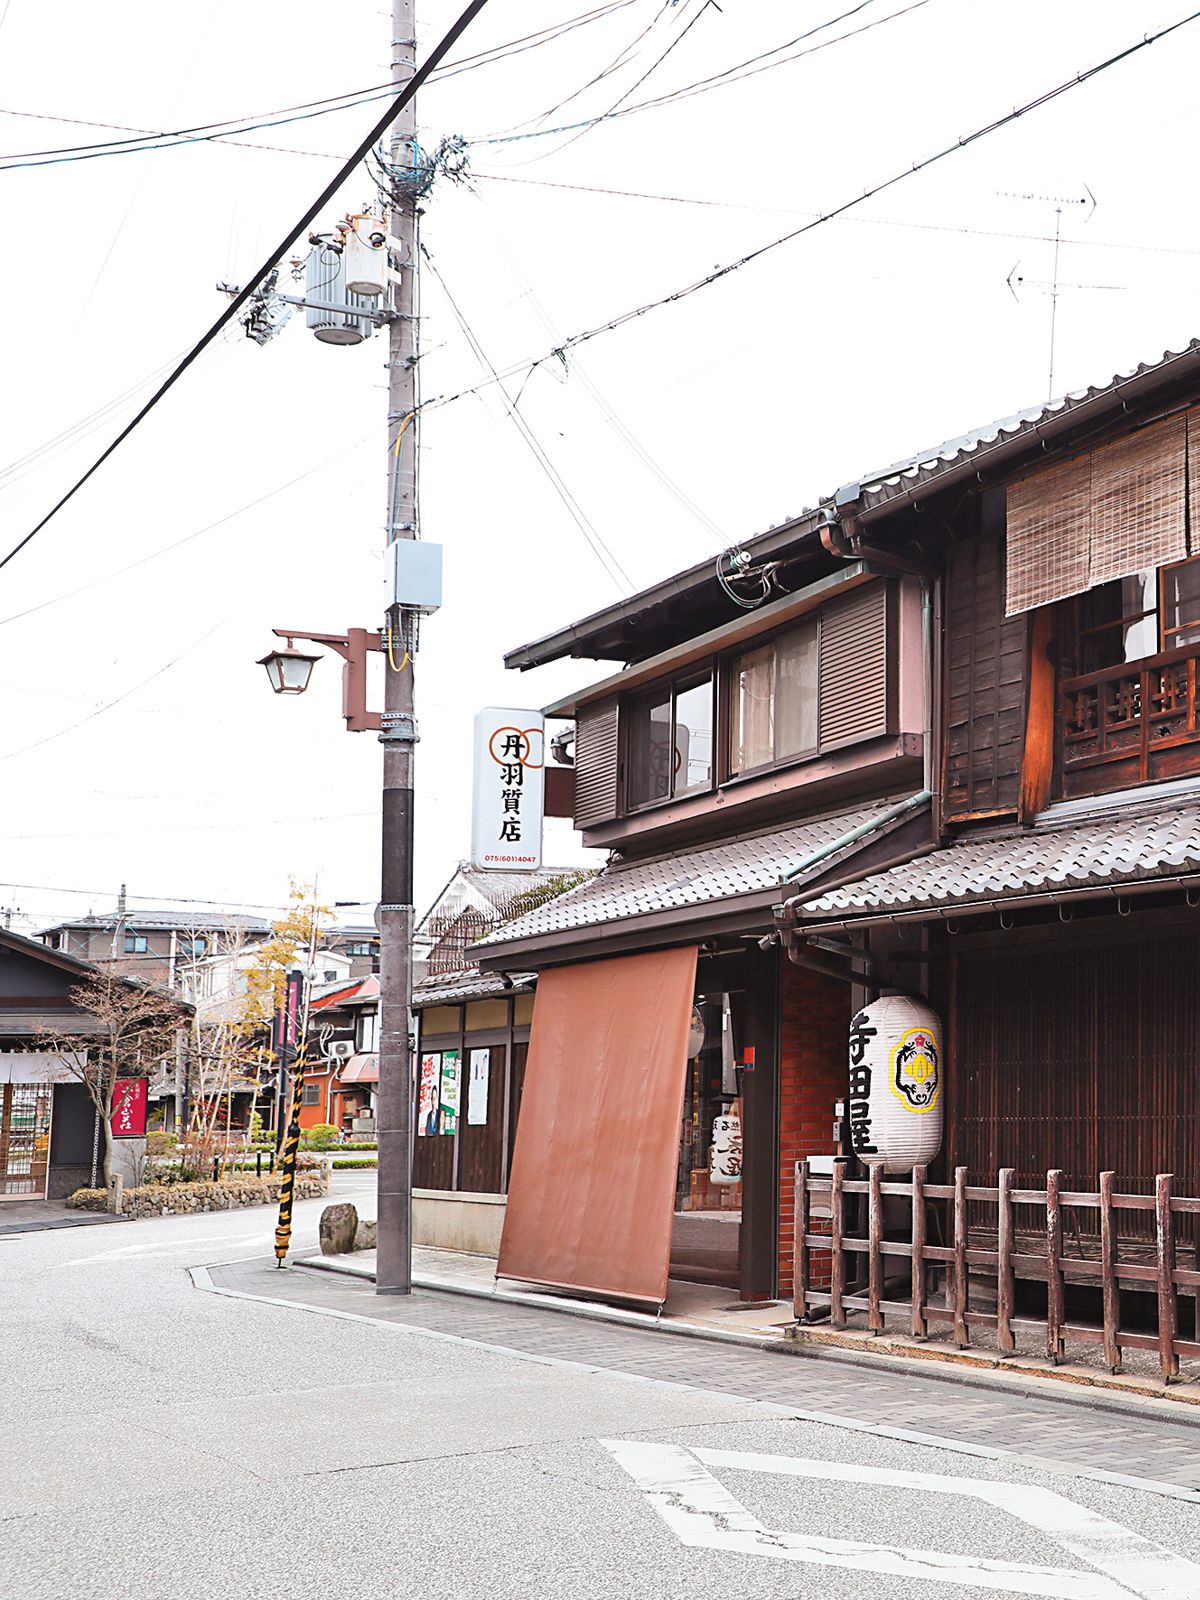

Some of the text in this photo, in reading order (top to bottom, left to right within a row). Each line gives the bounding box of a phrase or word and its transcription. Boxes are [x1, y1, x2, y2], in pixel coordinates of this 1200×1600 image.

[499, 734, 525, 842] 丹羽質店
[484, 854, 537, 863] 075(601)4047
[849, 1012, 878, 1154] 寺田屋
